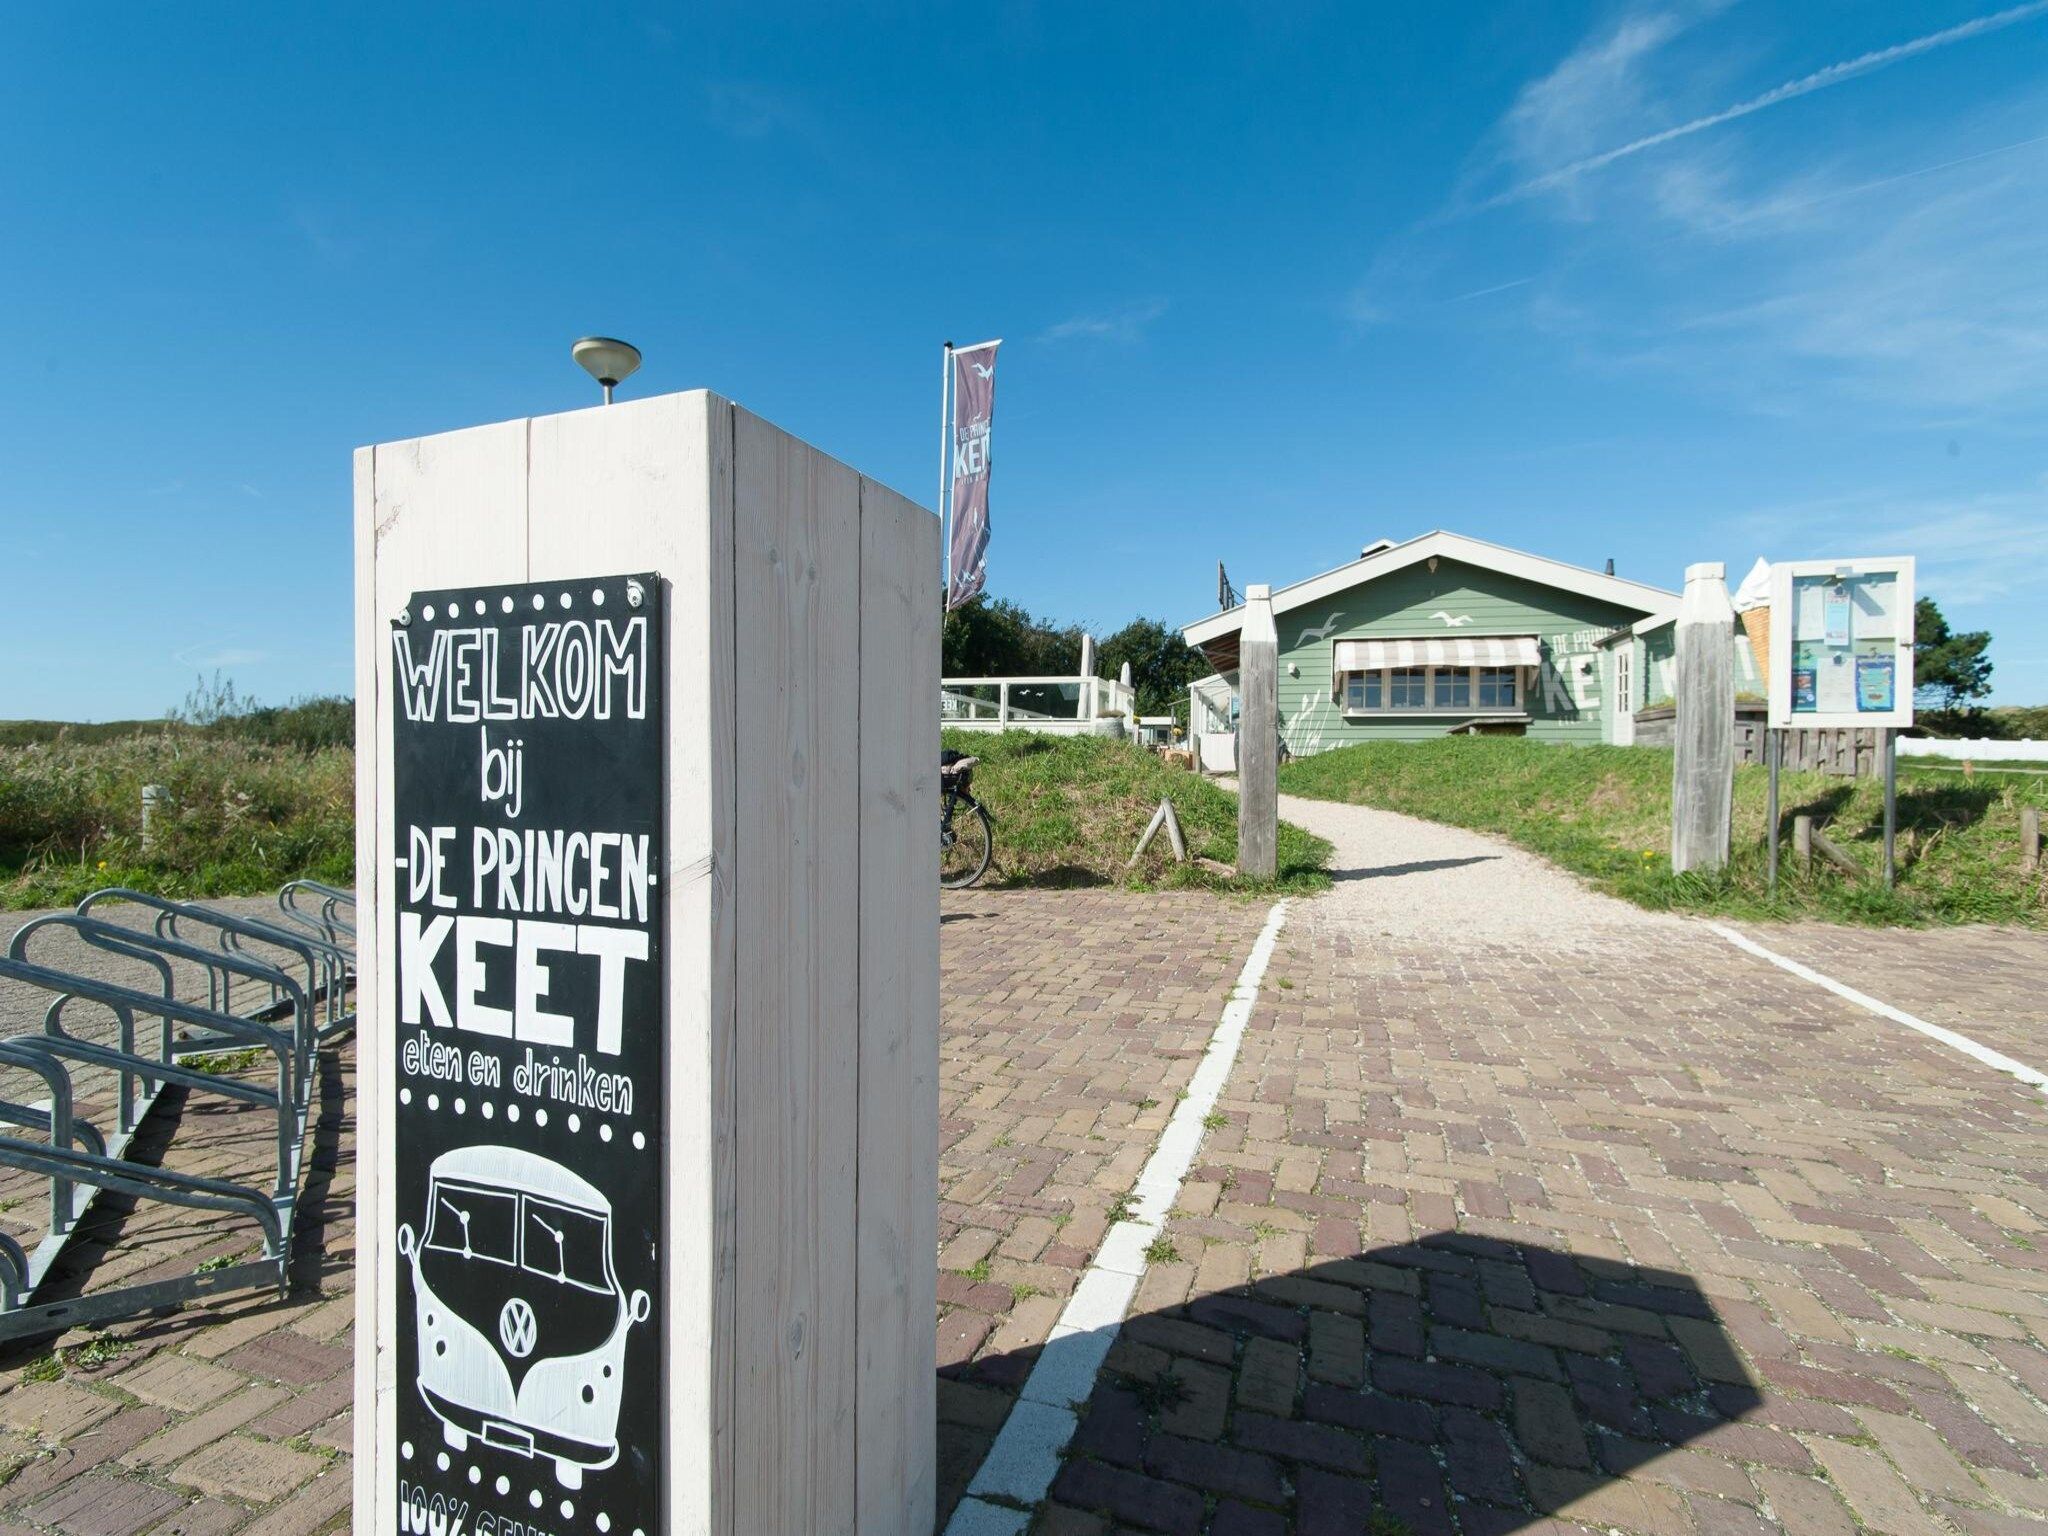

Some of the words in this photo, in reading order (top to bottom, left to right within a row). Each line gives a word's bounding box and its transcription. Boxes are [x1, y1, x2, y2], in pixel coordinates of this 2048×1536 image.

[393, 617, 647, 723] WELKOM
[1541, 652, 1602, 714] KE
[481, 725, 524, 818] bij
[400, 911, 649, 1056] KEET
[403, 1030, 462, 1082] eten
[468, 1051, 500, 1088] en
[513, 1048, 633, 1115] drinken
[401, 1479, 469, 1536] 100%
